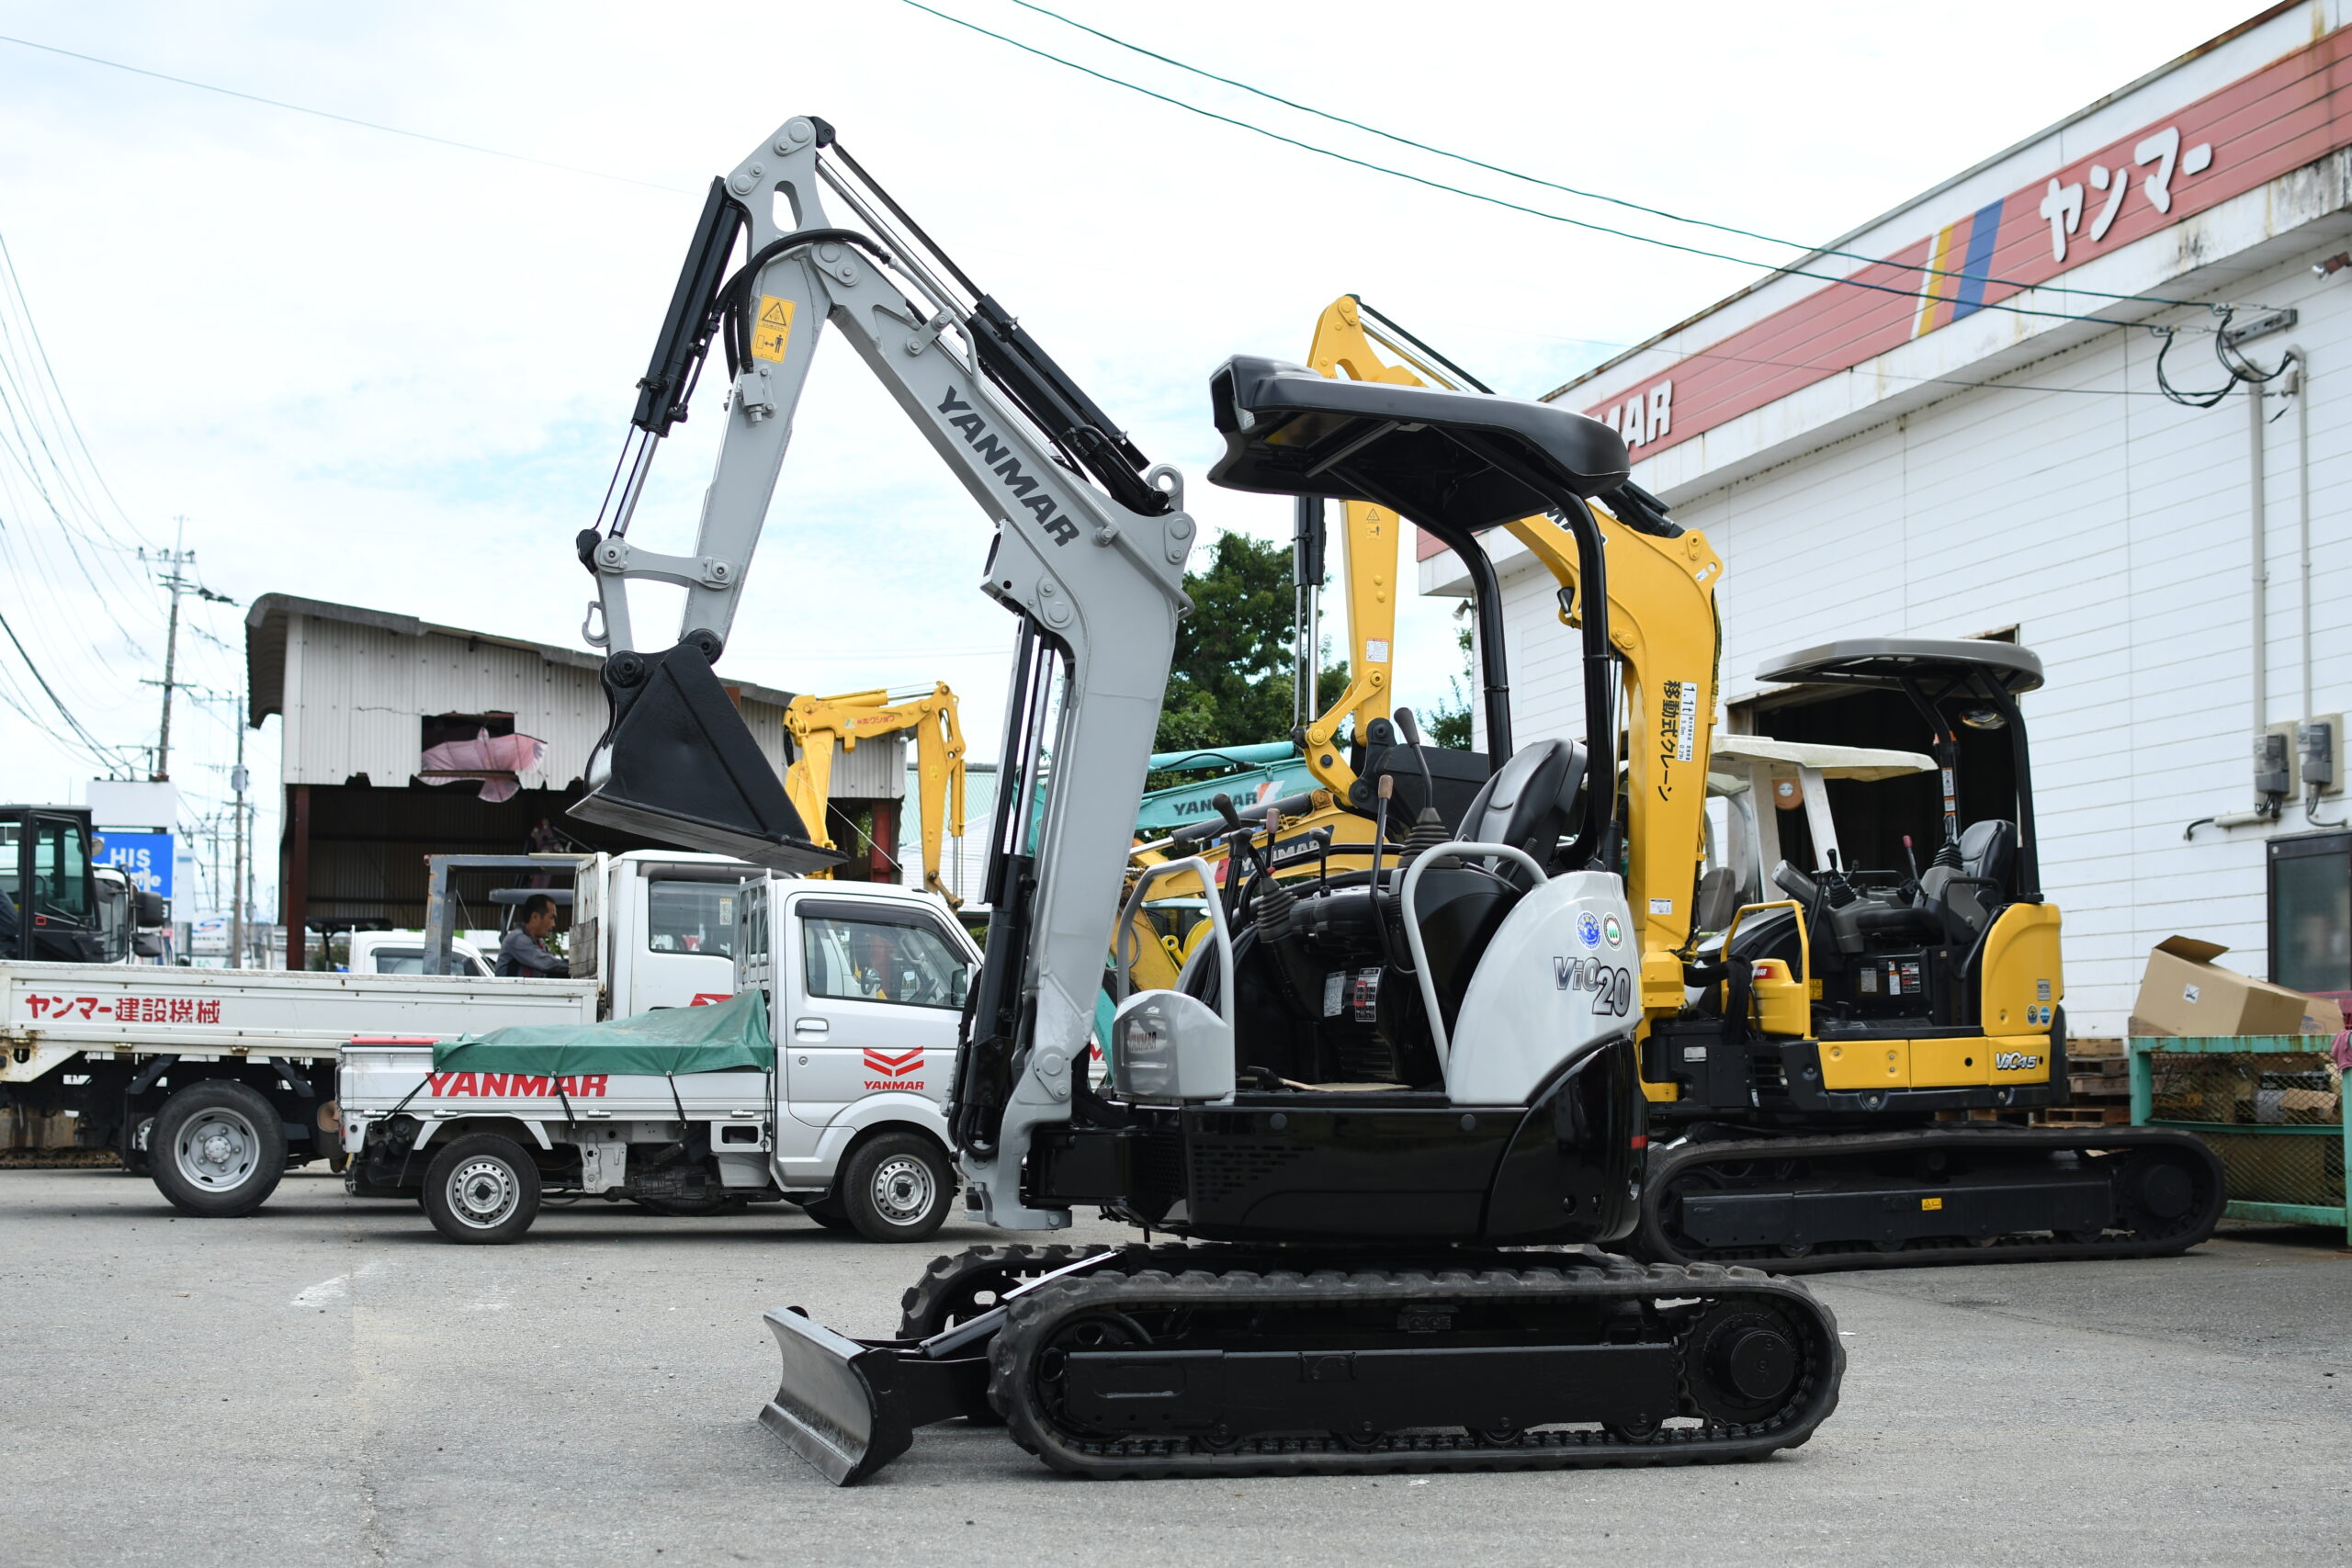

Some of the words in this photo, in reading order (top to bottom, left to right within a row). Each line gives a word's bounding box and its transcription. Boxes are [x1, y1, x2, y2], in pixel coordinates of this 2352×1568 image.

[2040, 126, 2212, 263] ヤンマー
[937, 385, 1080, 547] YANMAR
[1658, 681, 1680, 802] 移動式クレーン
[1173, 792, 1258, 817] YANAR
[425, 1071, 608, 1097] YANMAR
[864, 1080, 924, 1090] YANMAR
